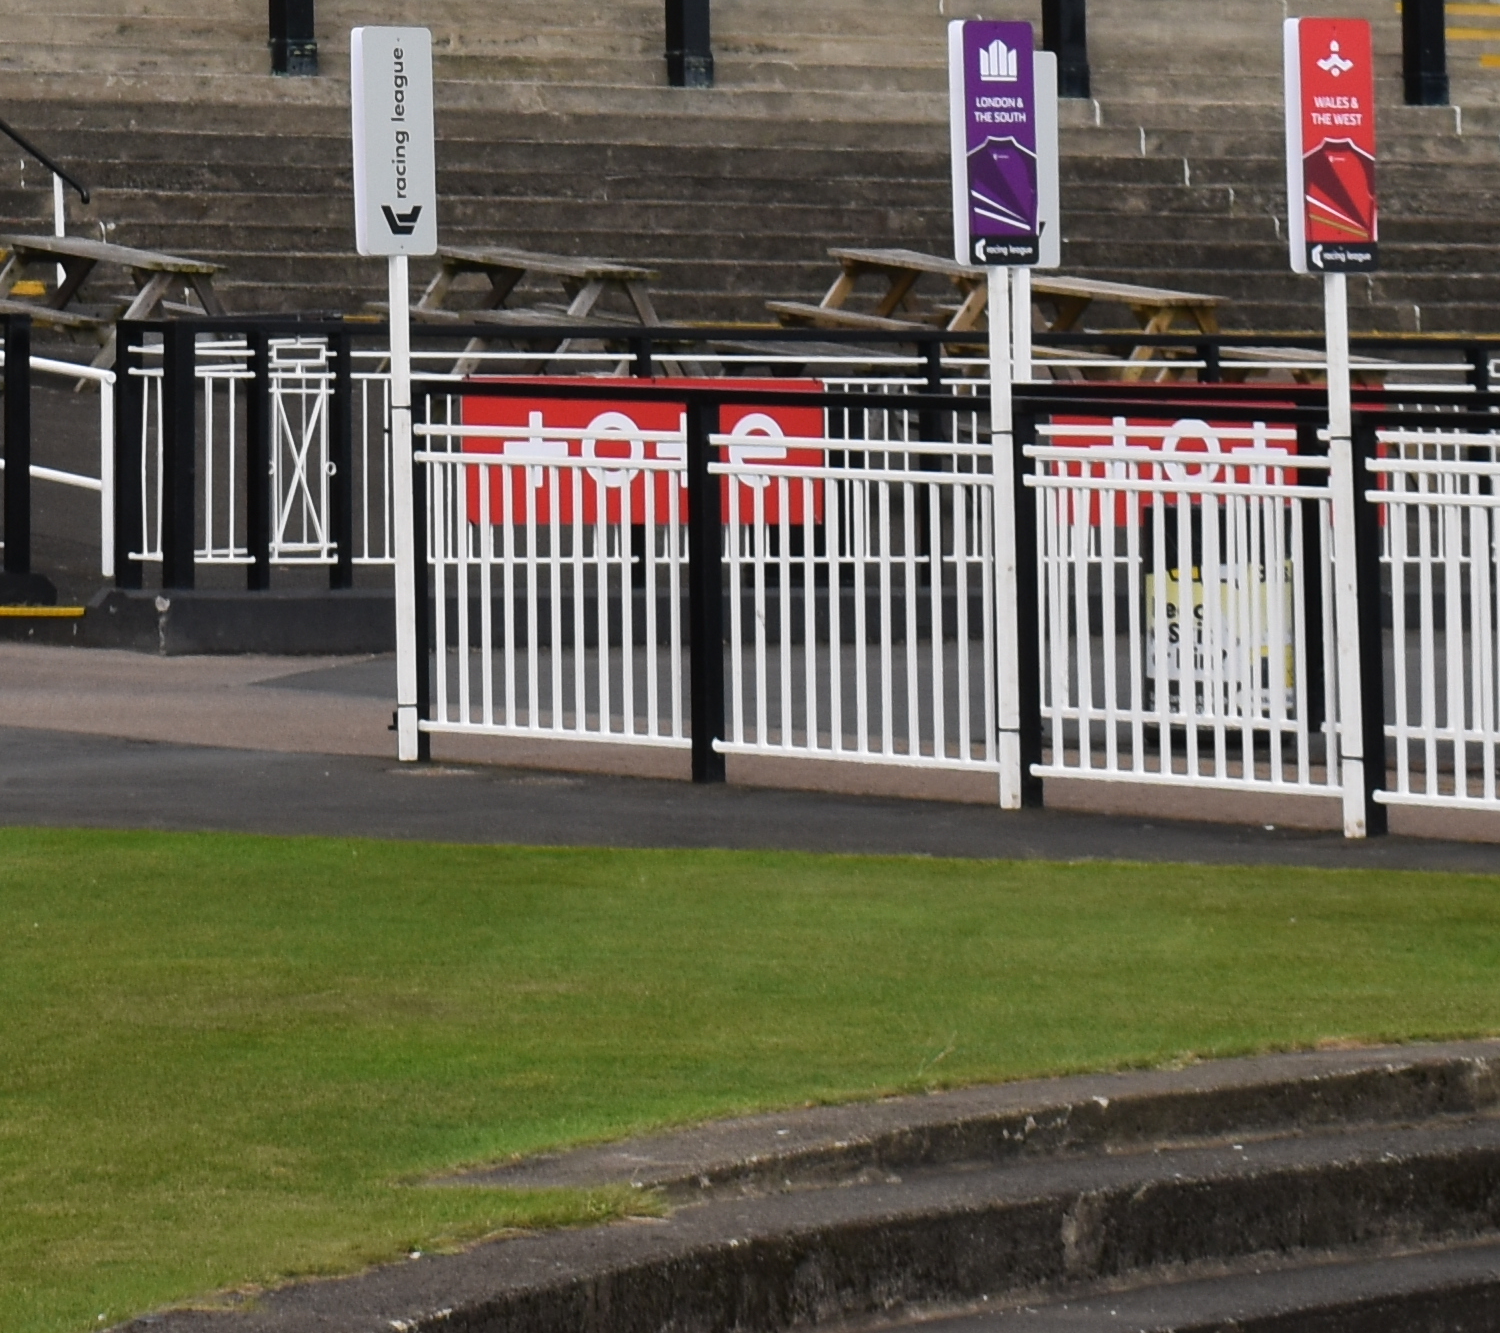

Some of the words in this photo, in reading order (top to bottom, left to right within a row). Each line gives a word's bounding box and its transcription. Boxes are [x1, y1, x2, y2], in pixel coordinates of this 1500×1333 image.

[391, 47, 408, 122] league
[976, 96, 1015, 109] LONDON
[1016, 97, 1024, 109] &
[1314, 96, 1349, 109] WALES
[1350, 97, 1359, 109] &
[974, 111, 993, 123] THE
[994, 111, 1027, 124] SOUTH
[1311, 112, 1332, 125] THE
[1333, 113, 1362, 126] WEST
[391, 130, 411, 199] racing
[1089, 416, 1288, 483] tot
